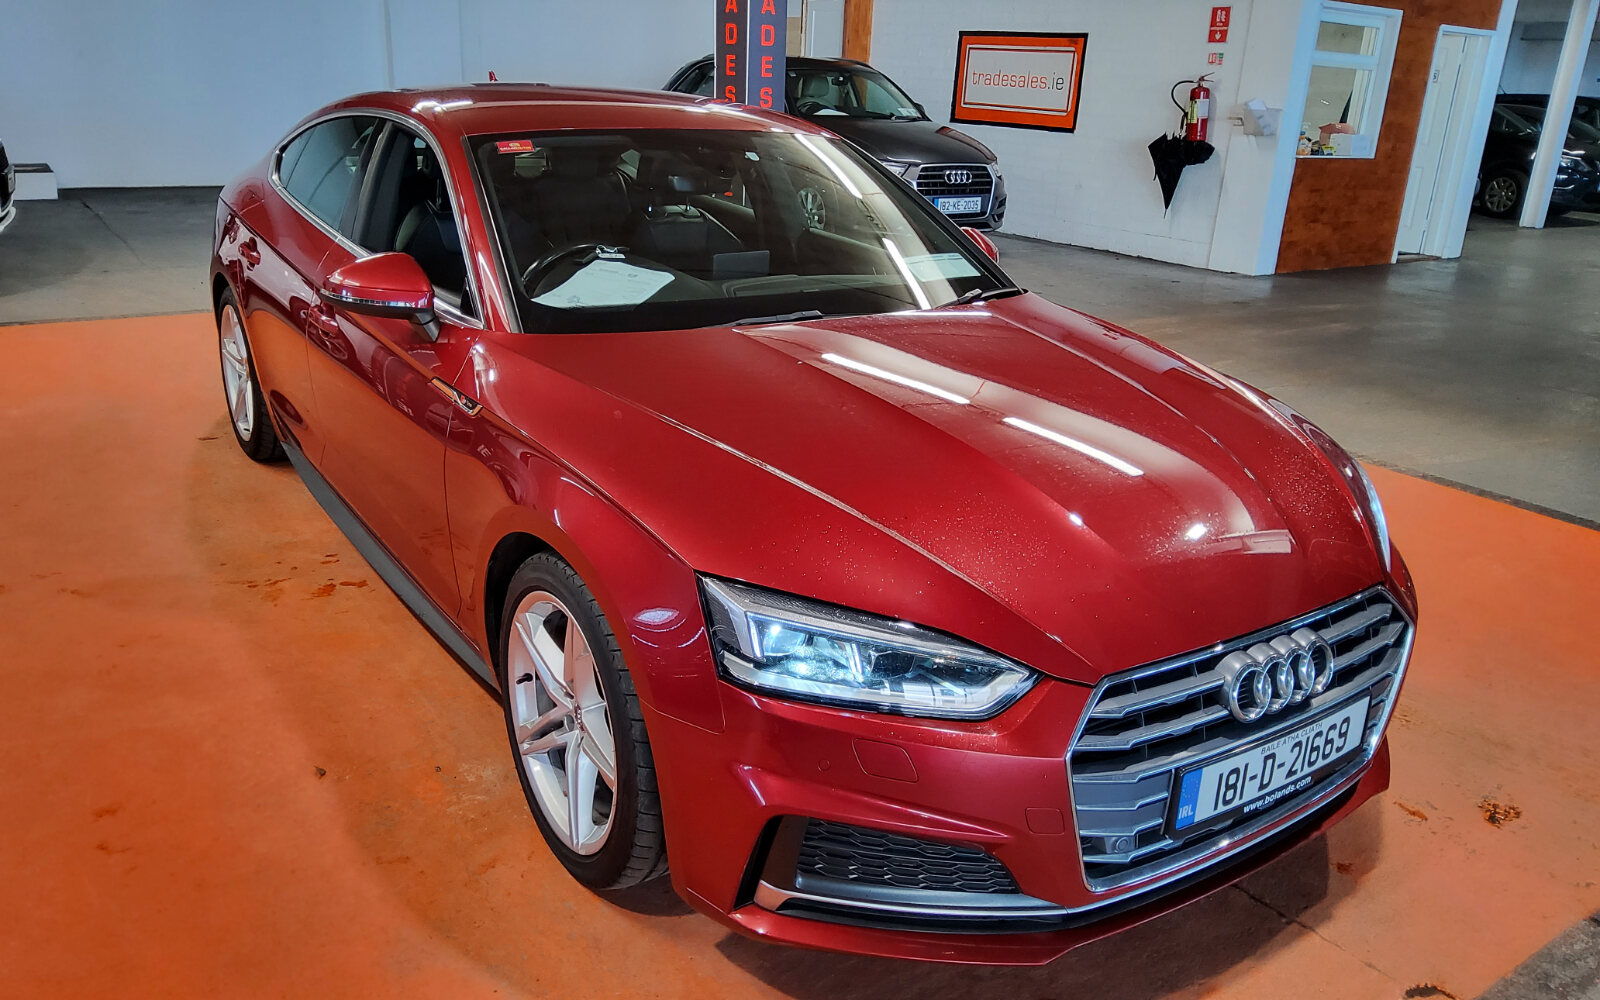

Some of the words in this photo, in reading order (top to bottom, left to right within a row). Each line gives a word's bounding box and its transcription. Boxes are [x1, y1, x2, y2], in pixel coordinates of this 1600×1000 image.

[972, 69, 1065, 91] tradesales.ie
[1261, 740, 1281, 754] BAILE
[1301, 722, 1323, 737] CLIATH
[1213, 716, 1351, 812] 181-D-21669
[1243, 776, 1312, 813] www.bolands.com
[1178, 803, 1194, 820] IRL
